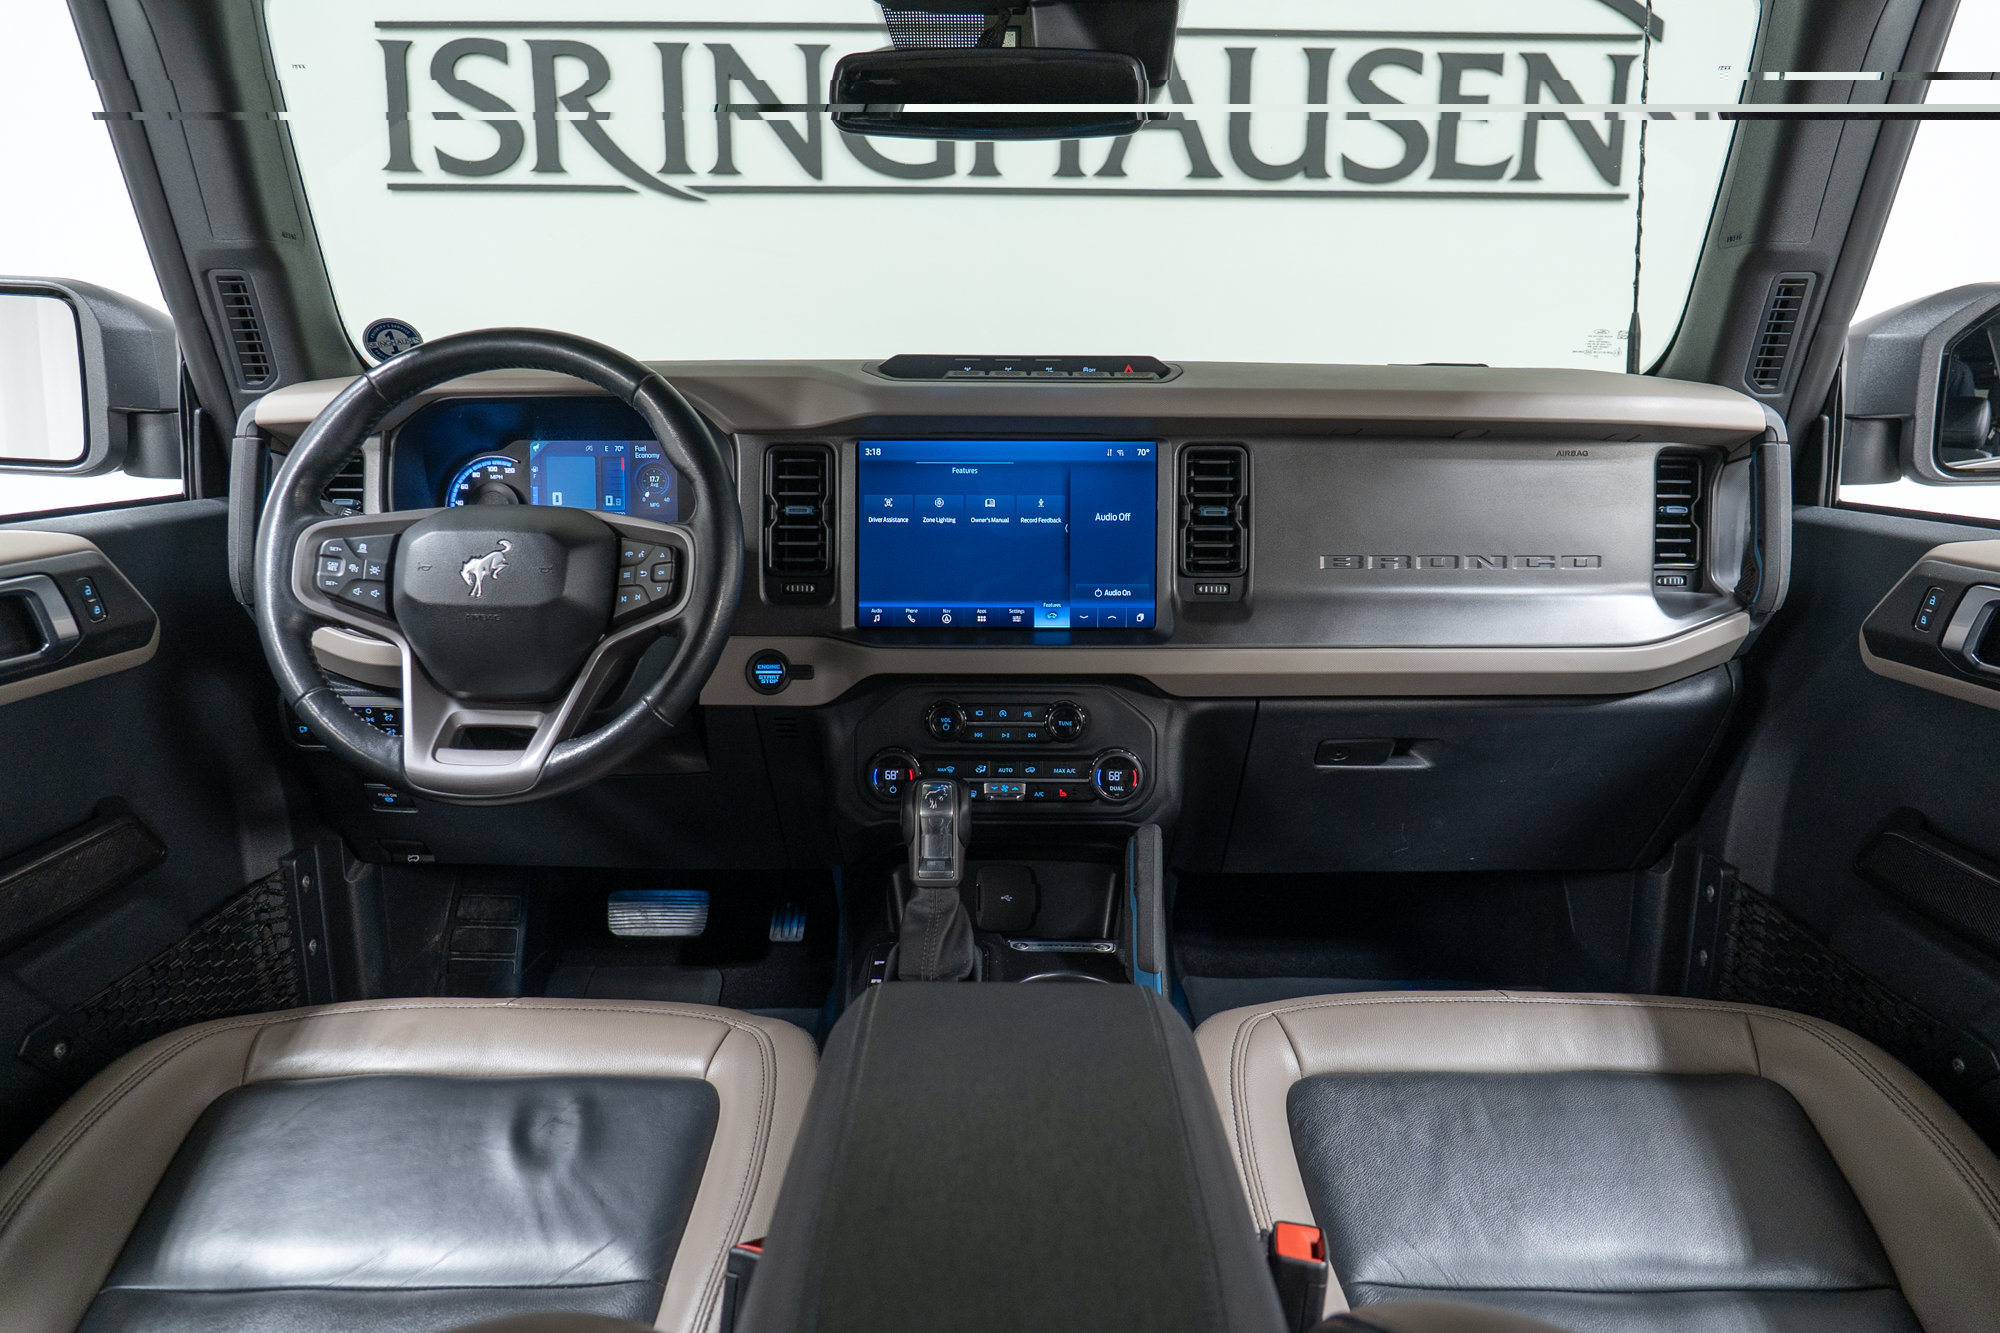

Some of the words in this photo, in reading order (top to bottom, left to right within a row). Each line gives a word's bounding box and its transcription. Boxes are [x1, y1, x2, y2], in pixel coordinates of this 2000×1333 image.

[634, 452, 660, 460] Economy
[865, 448, 881, 456] 3:18
[952, 467, 978, 475] Features
[936, 516, 956, 524] Lighting
[1095, 512, 1117, 522] Audio
[1118, 512, 1131, 522] Off
[1319, 554, 1603, 571] BRONCO
[1104, 589, 1121, 597] Audio
[1121, 589, 1132, 597] On
